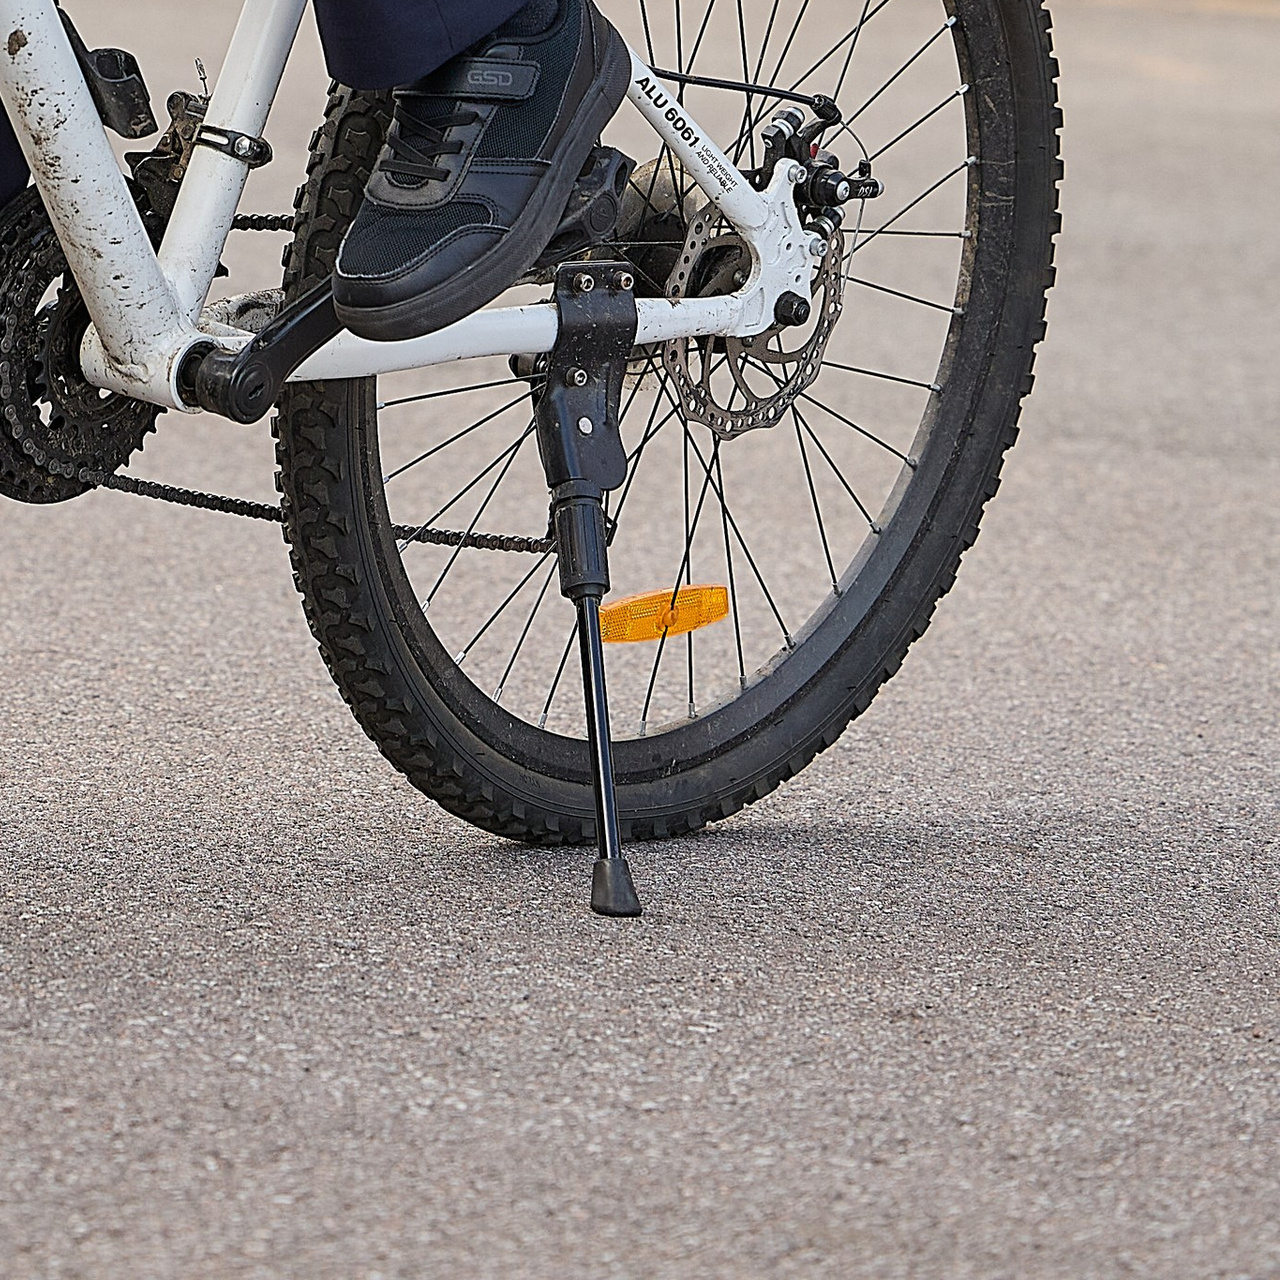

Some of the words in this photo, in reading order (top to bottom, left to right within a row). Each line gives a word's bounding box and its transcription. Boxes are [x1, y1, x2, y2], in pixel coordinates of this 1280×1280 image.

[467, 70, 513, 86] GSD
[634, 76, 669, 109] ALU
[664, 107, 701, 148] 6061
[695, 151, 710, 166] AND
[707, 163, 734, 194] RELIABLE
